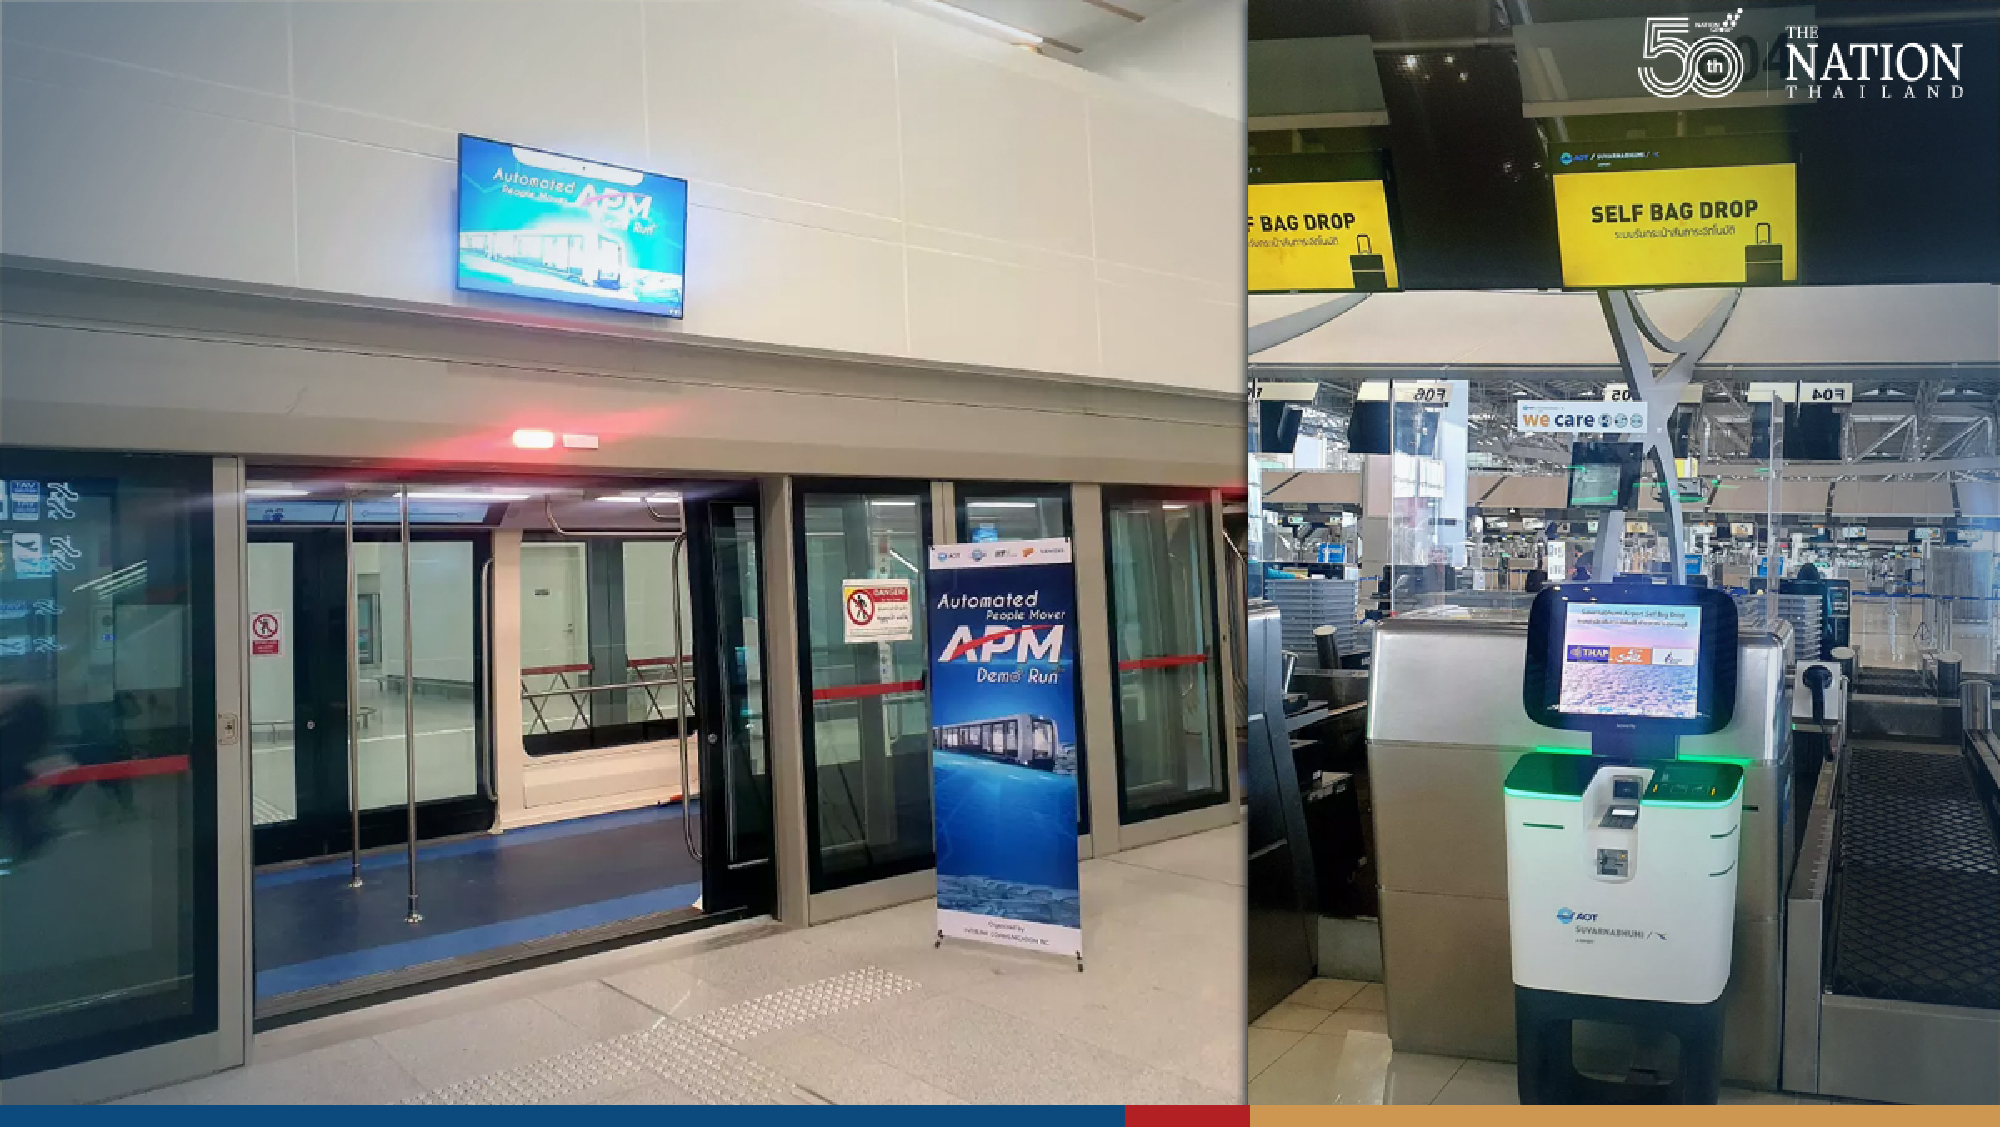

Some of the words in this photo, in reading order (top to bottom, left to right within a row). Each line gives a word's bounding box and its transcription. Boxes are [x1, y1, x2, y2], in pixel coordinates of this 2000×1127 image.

[493, 167, 575, 193] Automated
[576, 183, 653, 219] APM
[1591, 203, 1644, 223] SELF
[1650, 202, 1693, 221] BAG
[1699, 200, 1758, 219] DROP
[1260, 215, 1299, 233] BAG
[1303, 213, 1356, 231] DROP
[1522, 414, 1550, 428] we
[1554, 413, 1595, 428] care
[937, 590, 1039, 610] Automated
[986, 610, 1026, 622] People
[1029, 609, 1066, 621] Mover
[937, 624, 1065, 663] APM
[977, 667, 1022, 683] Demo
[1028, 668, 1059, 684] Run
